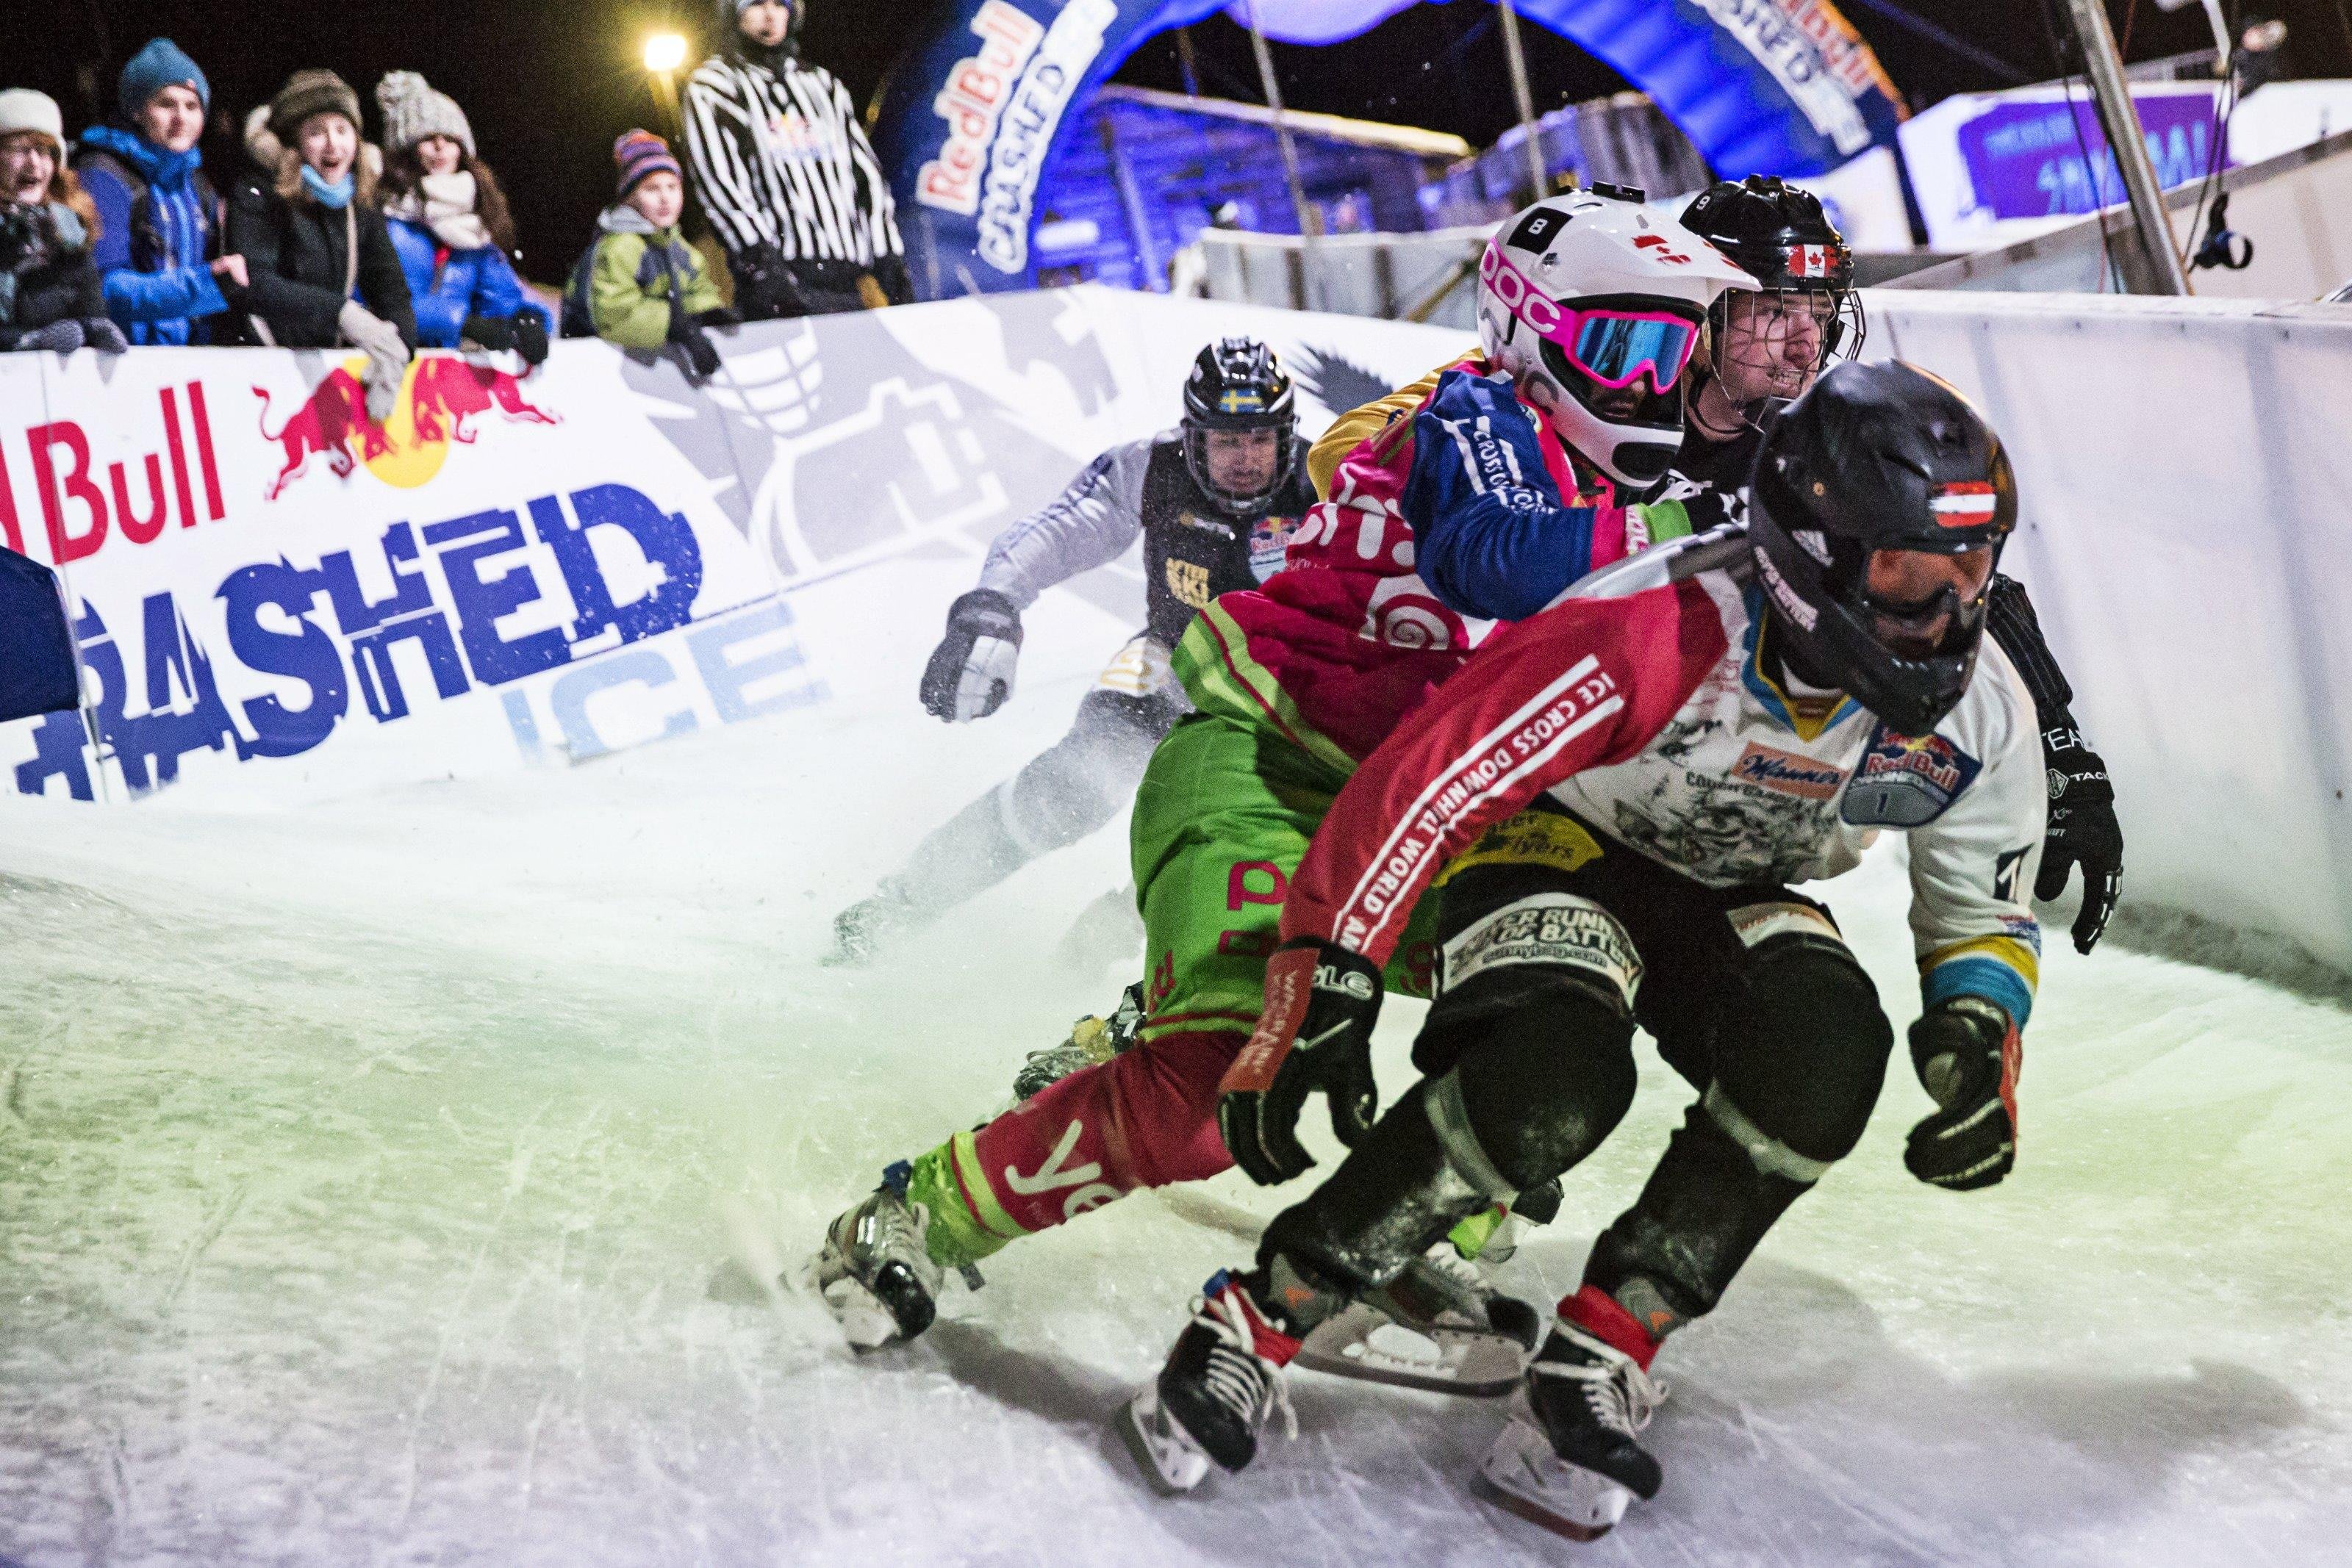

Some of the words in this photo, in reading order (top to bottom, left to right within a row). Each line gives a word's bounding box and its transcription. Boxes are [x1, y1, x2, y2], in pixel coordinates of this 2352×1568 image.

[926, 98, 986, 201] Red
[957, 3, 1032, 104] Bull
[26, 380, 226, 566] Bull
[15, 483, 703, 802] RASHED
[501, 600, 831, 767] ICE
[1515, 702, 1577, 758] CROSS
[1575, 672, 1615, 707] ICE
[1416, 749, 1514, 836] DOWNHILL
[1865, 752, 1912, 774] Red
[1912, 750, 1961, 793] Bull
[1363, 835, 1426, 916] WORLD
